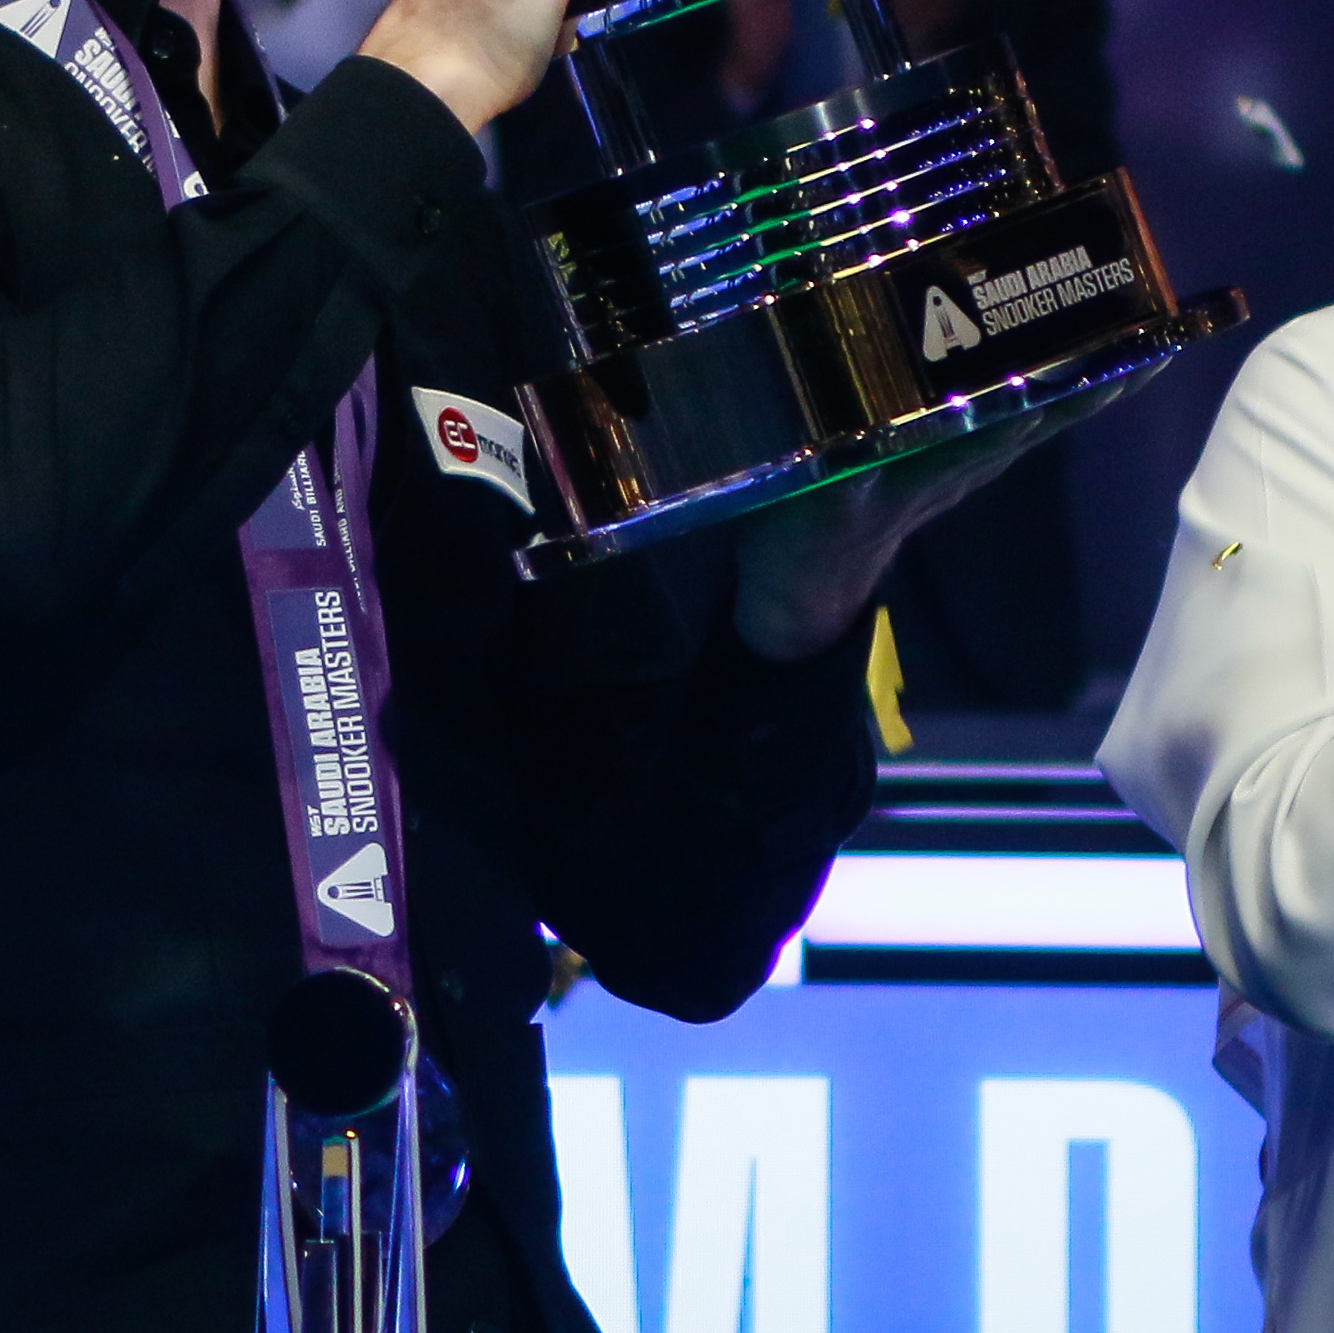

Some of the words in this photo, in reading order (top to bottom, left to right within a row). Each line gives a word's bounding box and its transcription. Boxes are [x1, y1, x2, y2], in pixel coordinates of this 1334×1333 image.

[973, 271, 1028, 309] SAUDI
[1026, 246, 1092, 290] ARABIA
[982, 288, 1058, 335] SNOOKER
[1056, 258, 1134, 306] MASTERS
[310, 510, 326, 546] SAUDI
[315, 592, 360, 709] MASTERS
[295, 648, 337, 747] ARABIA
[314, 754, 350, 835] SAUDI
[337, 716, 378, 832] SNOOKER
